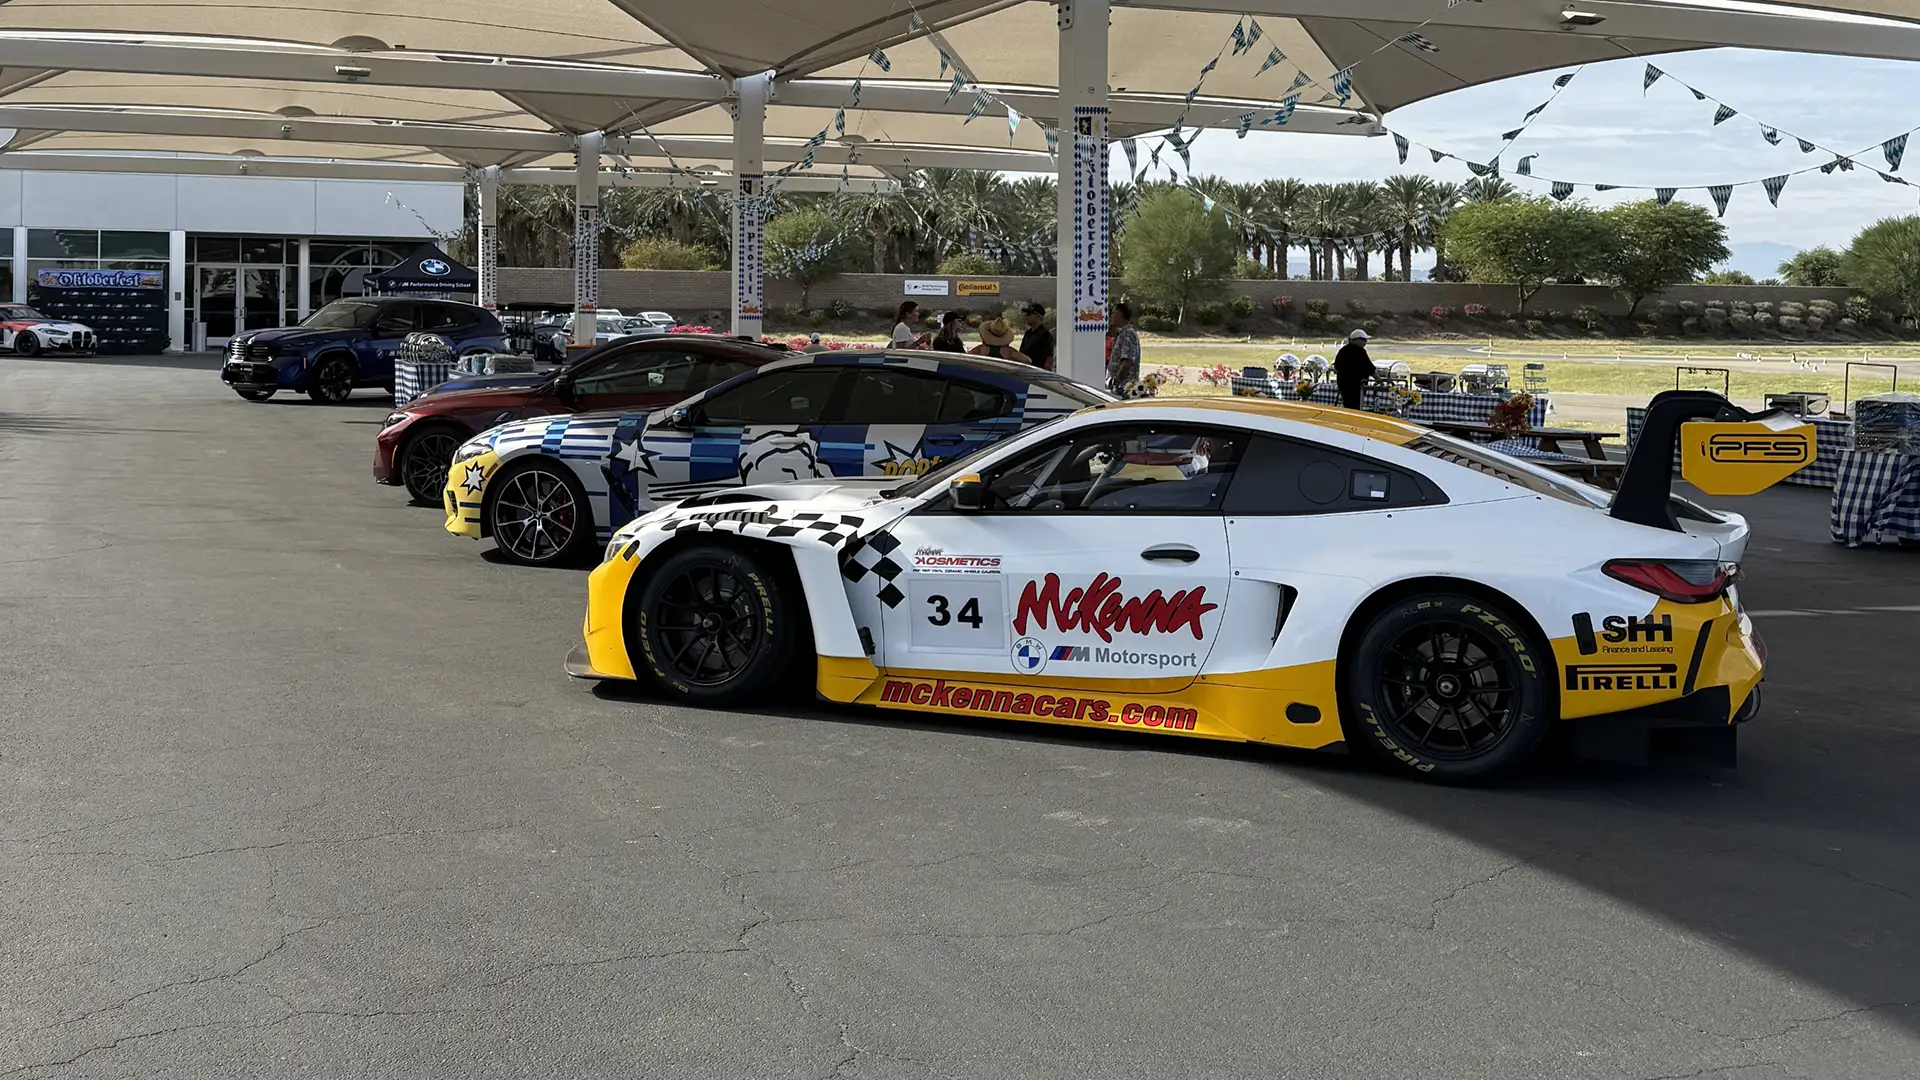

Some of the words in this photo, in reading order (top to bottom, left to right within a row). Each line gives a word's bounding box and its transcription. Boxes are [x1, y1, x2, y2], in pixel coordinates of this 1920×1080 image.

[58, 270, 141, 287] Oktoberfest
[958, 283, 993, 291] Continental
[747, 572, 774, 636] PIRELLI
[926, 594, 984, 629] 34
[1095, 648, 1197, 669] Motorsport
[1602, 645, 1630, 653] Finance
[1646, 646, 1674, 654] Leasing
[1564, 663, 1678, 691] PIRELLI
[880, 679, 1198, 731] mckennacars.com
[1359, 702, 1436, 773] PIRELLI
